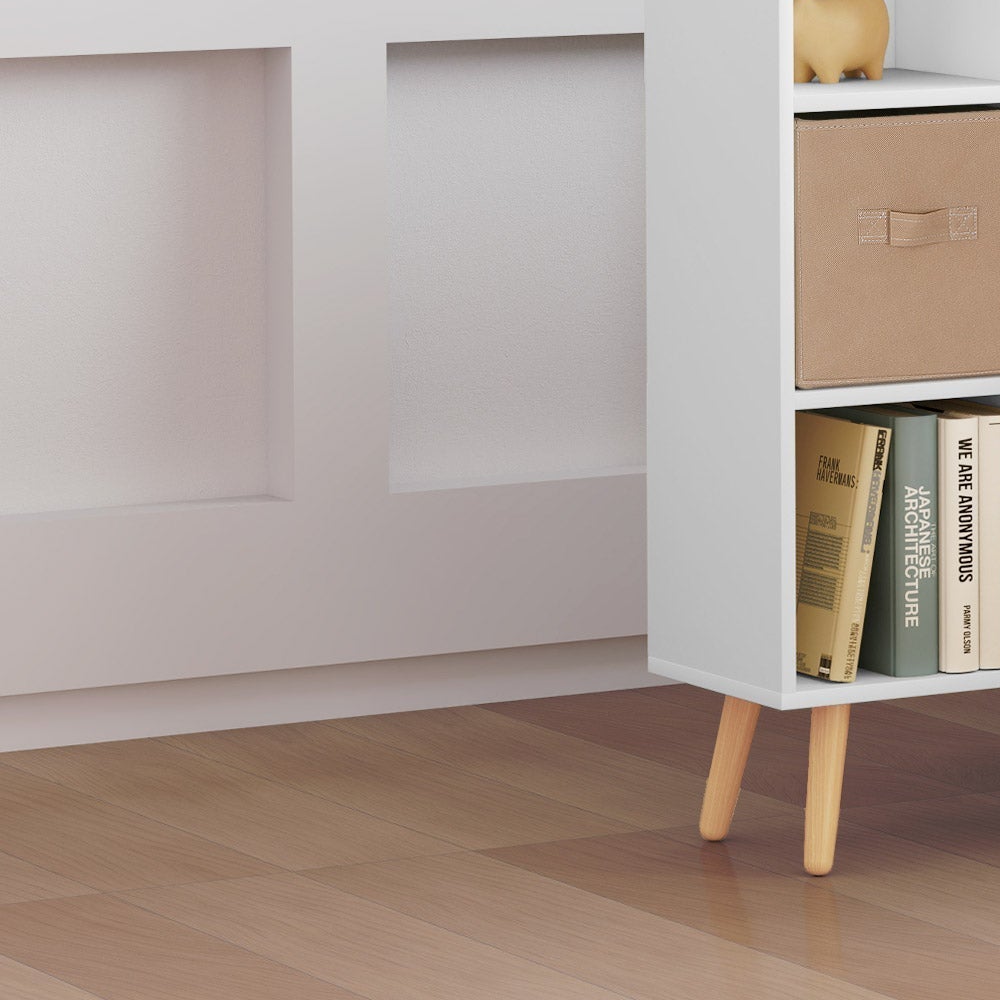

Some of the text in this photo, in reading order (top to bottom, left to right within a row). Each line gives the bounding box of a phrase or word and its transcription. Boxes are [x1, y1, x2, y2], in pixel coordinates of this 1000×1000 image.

[818, 455, 841, 471] FRANK
[873, 429, 888, 471] FRANK
[918, 486, 932, 580] JAPANESE
[958, 438, 973, 583] WE ARE ANONYMOUS
[904, 485, 919, 628] ARCHITECTURE
[963, 604, 972, 655] PARMY OLSON
